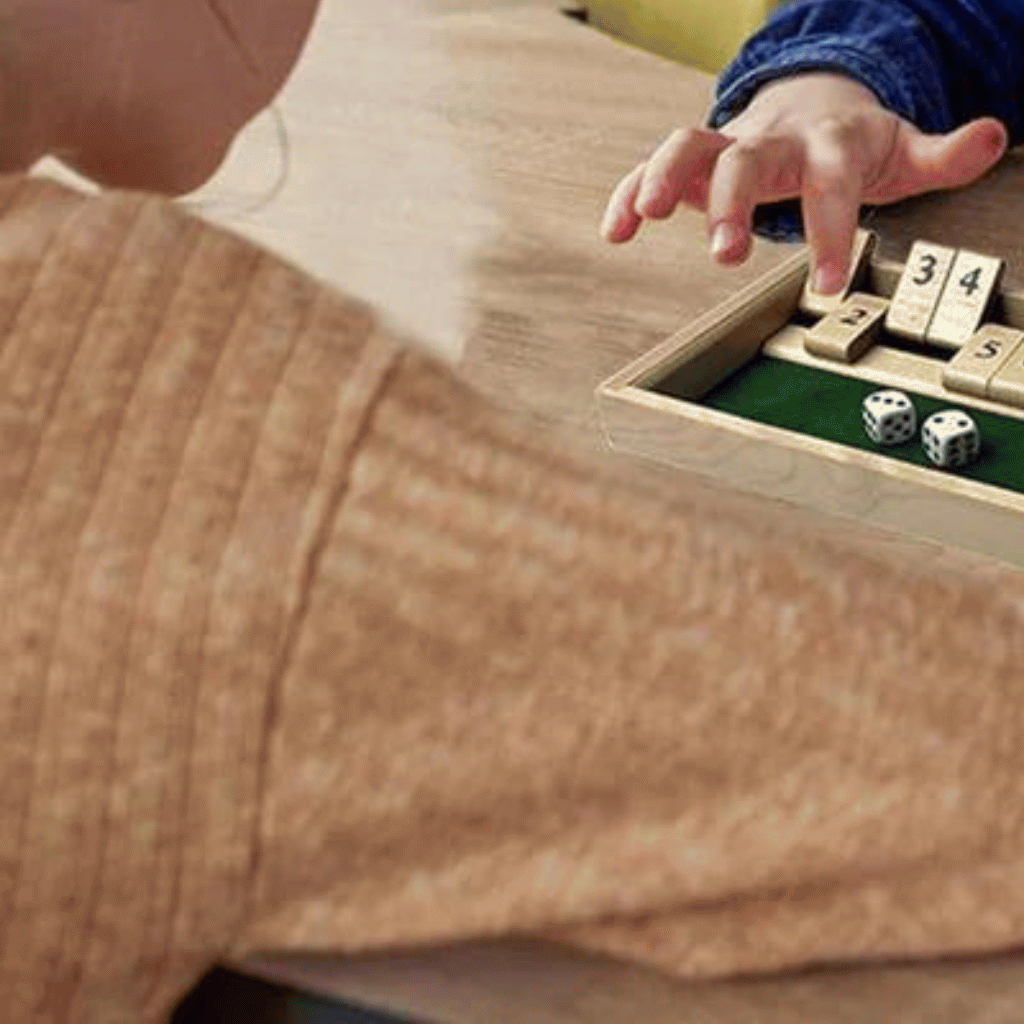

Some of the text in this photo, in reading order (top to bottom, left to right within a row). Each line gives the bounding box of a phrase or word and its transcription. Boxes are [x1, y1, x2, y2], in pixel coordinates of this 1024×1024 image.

[912, 254, 938, 285] 3
[959, 267, 983, 296] 4
[840, 308, 869, 325] 2
[974, 340, 1003, 359] 5
